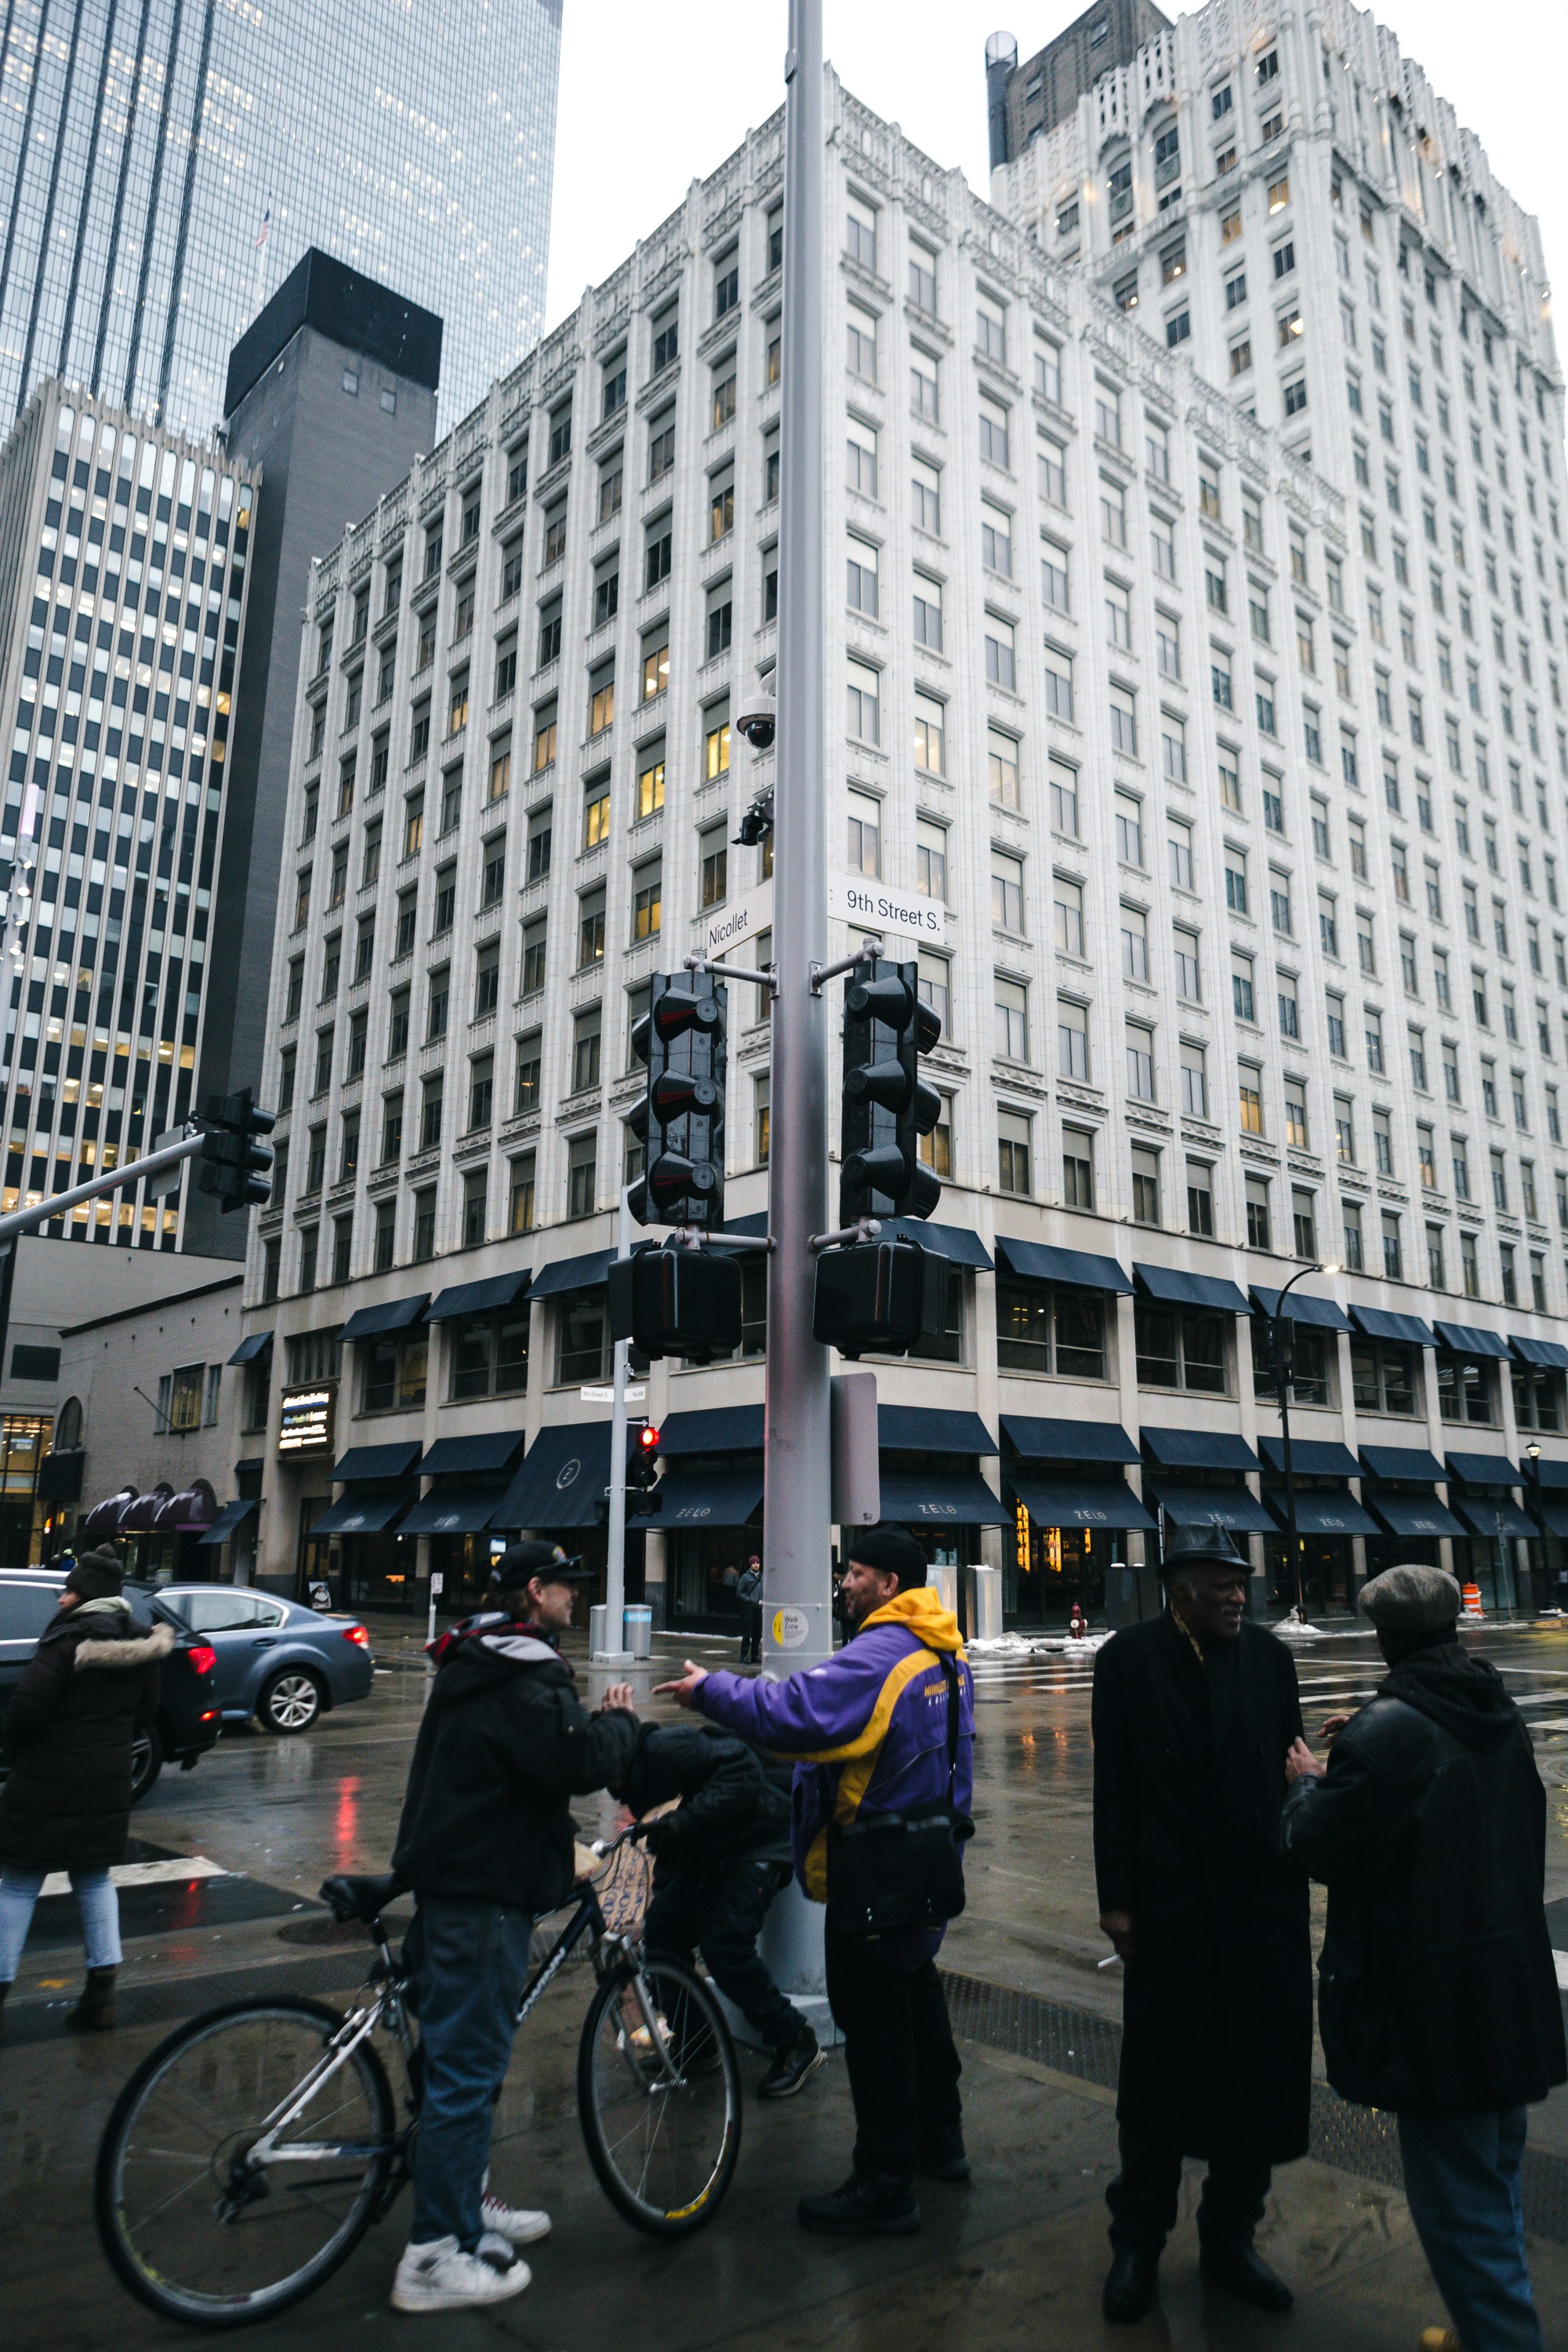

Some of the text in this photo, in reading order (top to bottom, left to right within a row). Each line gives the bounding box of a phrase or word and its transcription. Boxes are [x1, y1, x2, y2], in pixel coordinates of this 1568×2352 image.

[847, 890, 940, 931] 9th Street S.
[709, 909, 748, 948] Nicollet
[676, 1508, 710, 1518] ZELO
[919, 1504, 956, 1514] ZELO
[1074, 1510, 1106, 1519] ZELO
